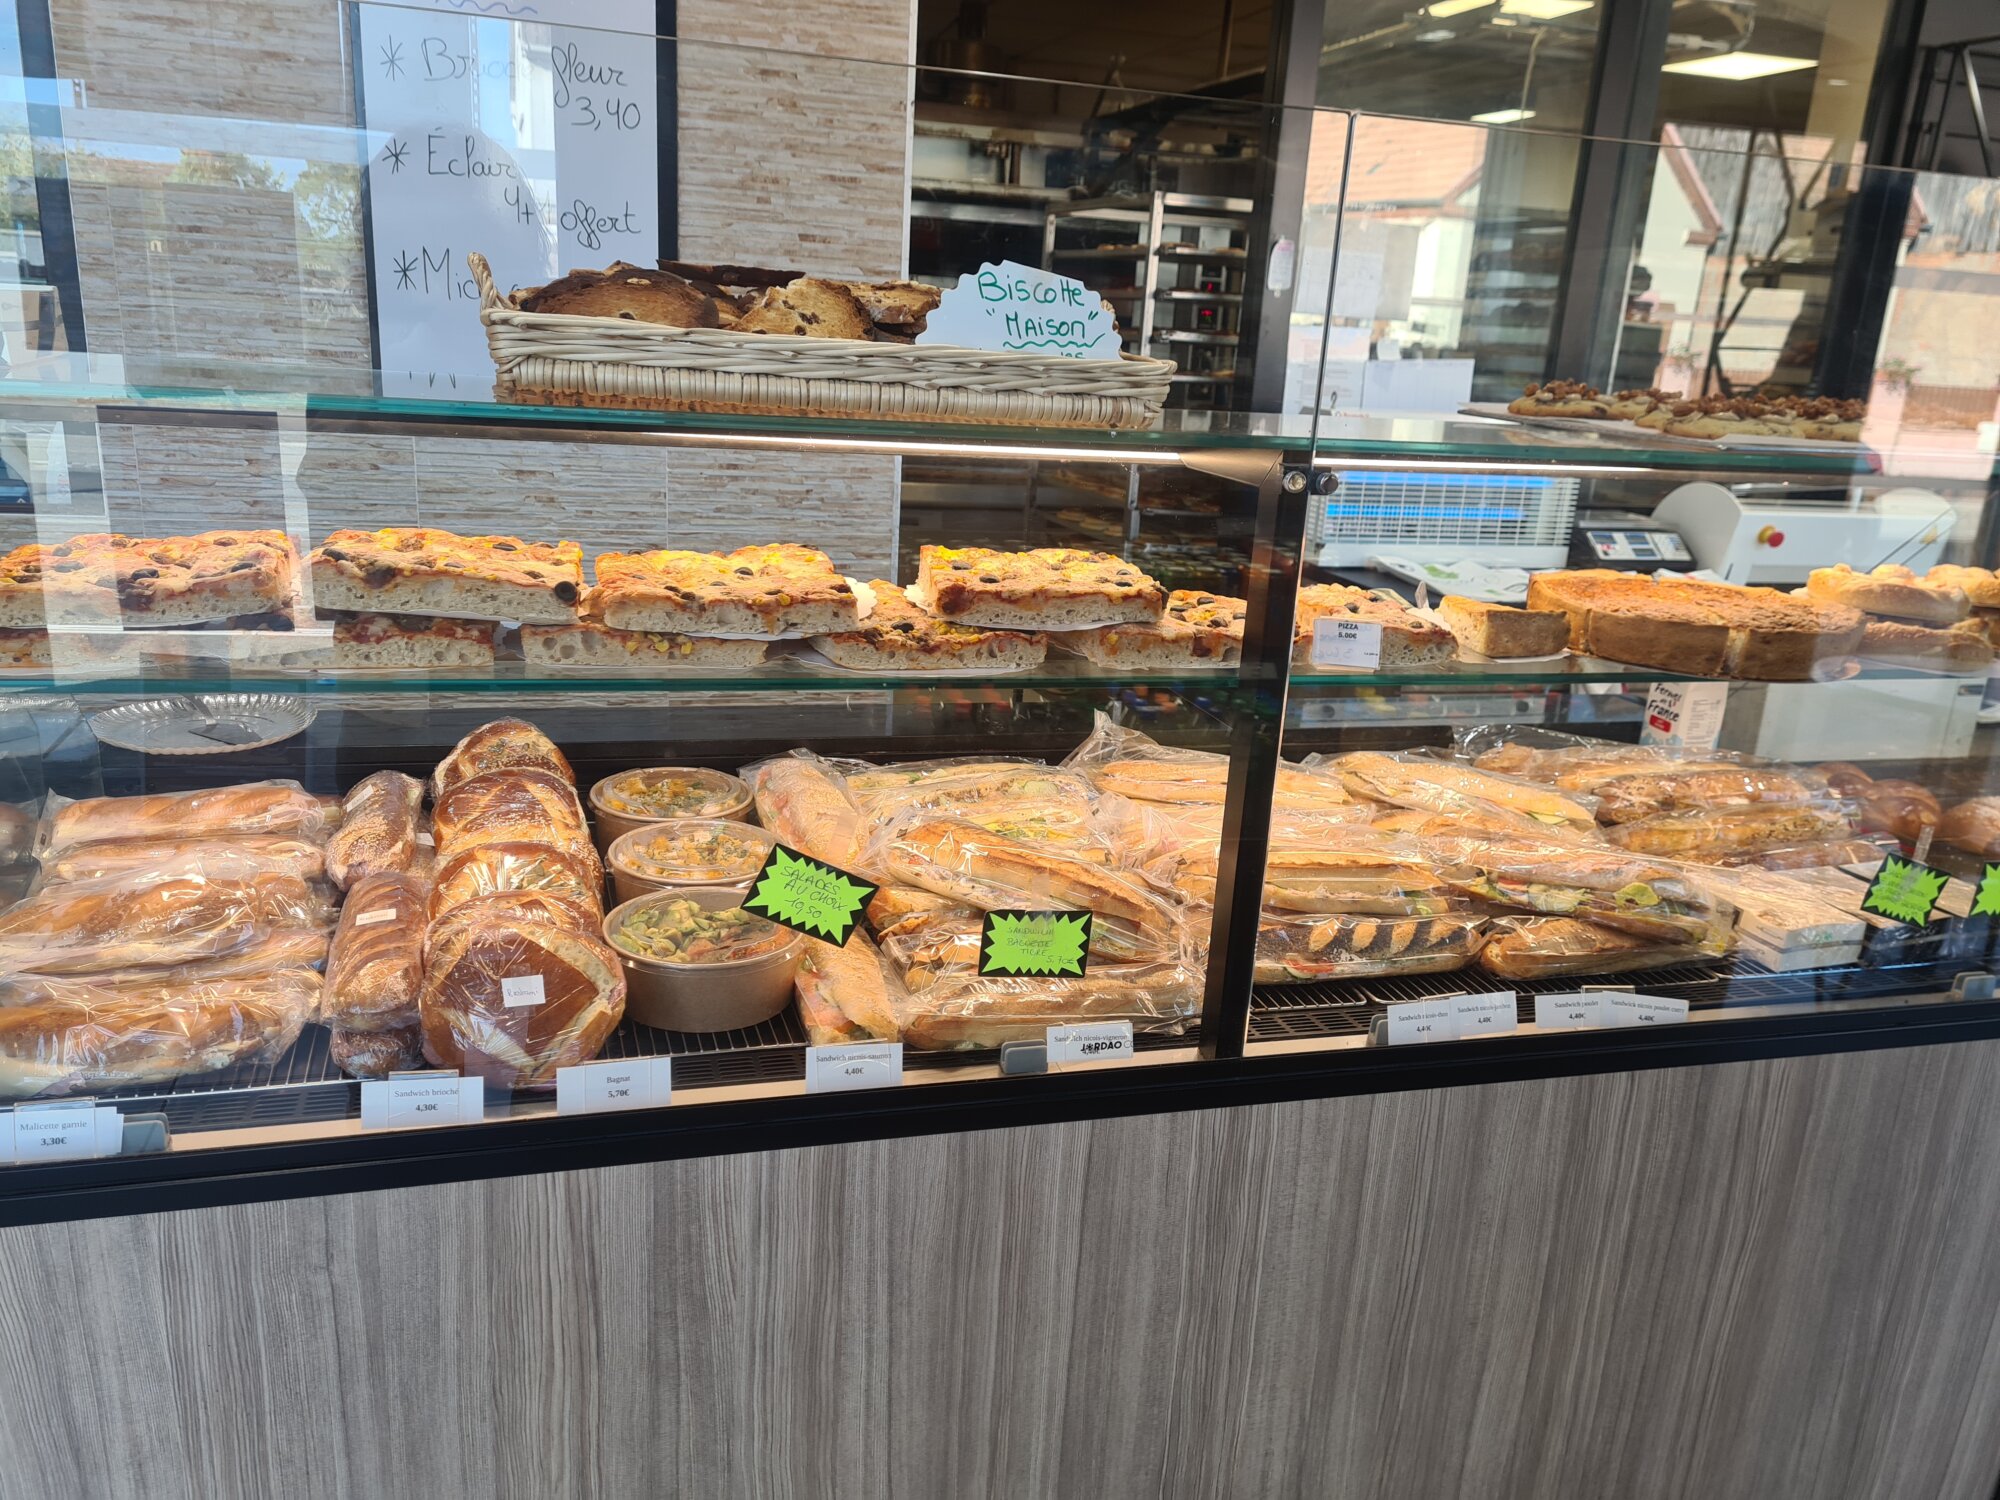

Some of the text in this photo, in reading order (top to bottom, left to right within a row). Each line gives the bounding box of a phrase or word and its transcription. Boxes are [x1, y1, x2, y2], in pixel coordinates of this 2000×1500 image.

[551, 42, 628, 109] fleur
[571, 97, 641, 131] 3,40
[428, 126, 519, 179] Éclair
[560, 199, 642, 251] offert
[1338, 622, 1359, 630] PIZZA
[1647, 699, 1680, 723] France
[780, 865, 841, 895] SALADES
[783, 879, 808, 895] AU
[1054, 1034, 1082, 1042] Sandich
[816, 1054, 846, 1063] Sandwich
[844, 1067, 864, 1076] 4,40€
[606, 1075, 630, 1084] Bagnat
[395, 1088, 430, 1098] Sandwich
[608, 1088, 630, 1099] 5,70€
[415, 1103, 439, 1112] 4,30€
[20, 1119, 88, 1132] Malicette garnie
[40, 1136, 68, 1147] 3,30€
